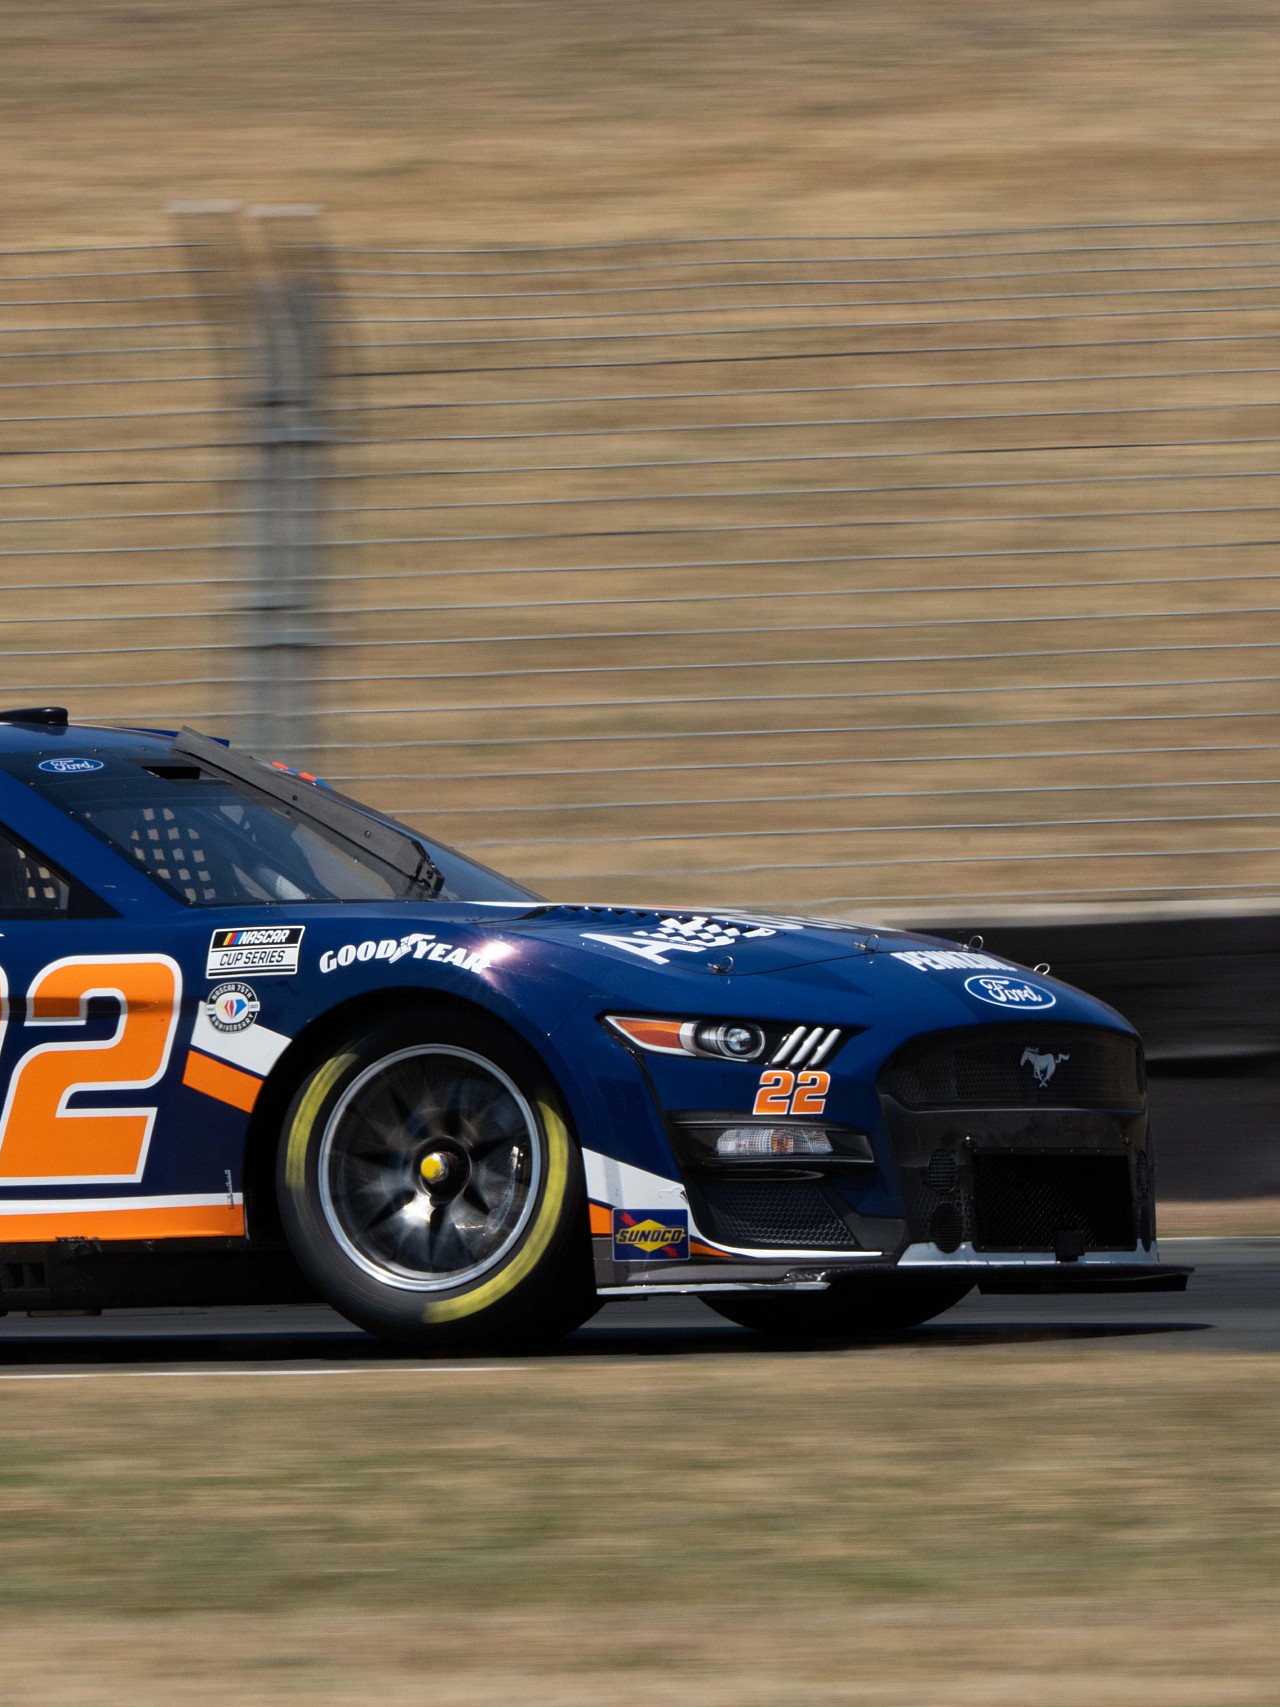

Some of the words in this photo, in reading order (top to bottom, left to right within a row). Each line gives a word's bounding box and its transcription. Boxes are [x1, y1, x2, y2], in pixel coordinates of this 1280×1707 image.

[49, 759, 95, 771] Ford
[237, 929, 291, 946] NASCAR
[219, 952, 244, 967] CUP
[243, 949, 286, 965] SERIES
[979, 978, 1043, 1002] Ford
[752, 1070, 831, 1116] 22
[618, 1229, 684, 1243] SUNOCO
